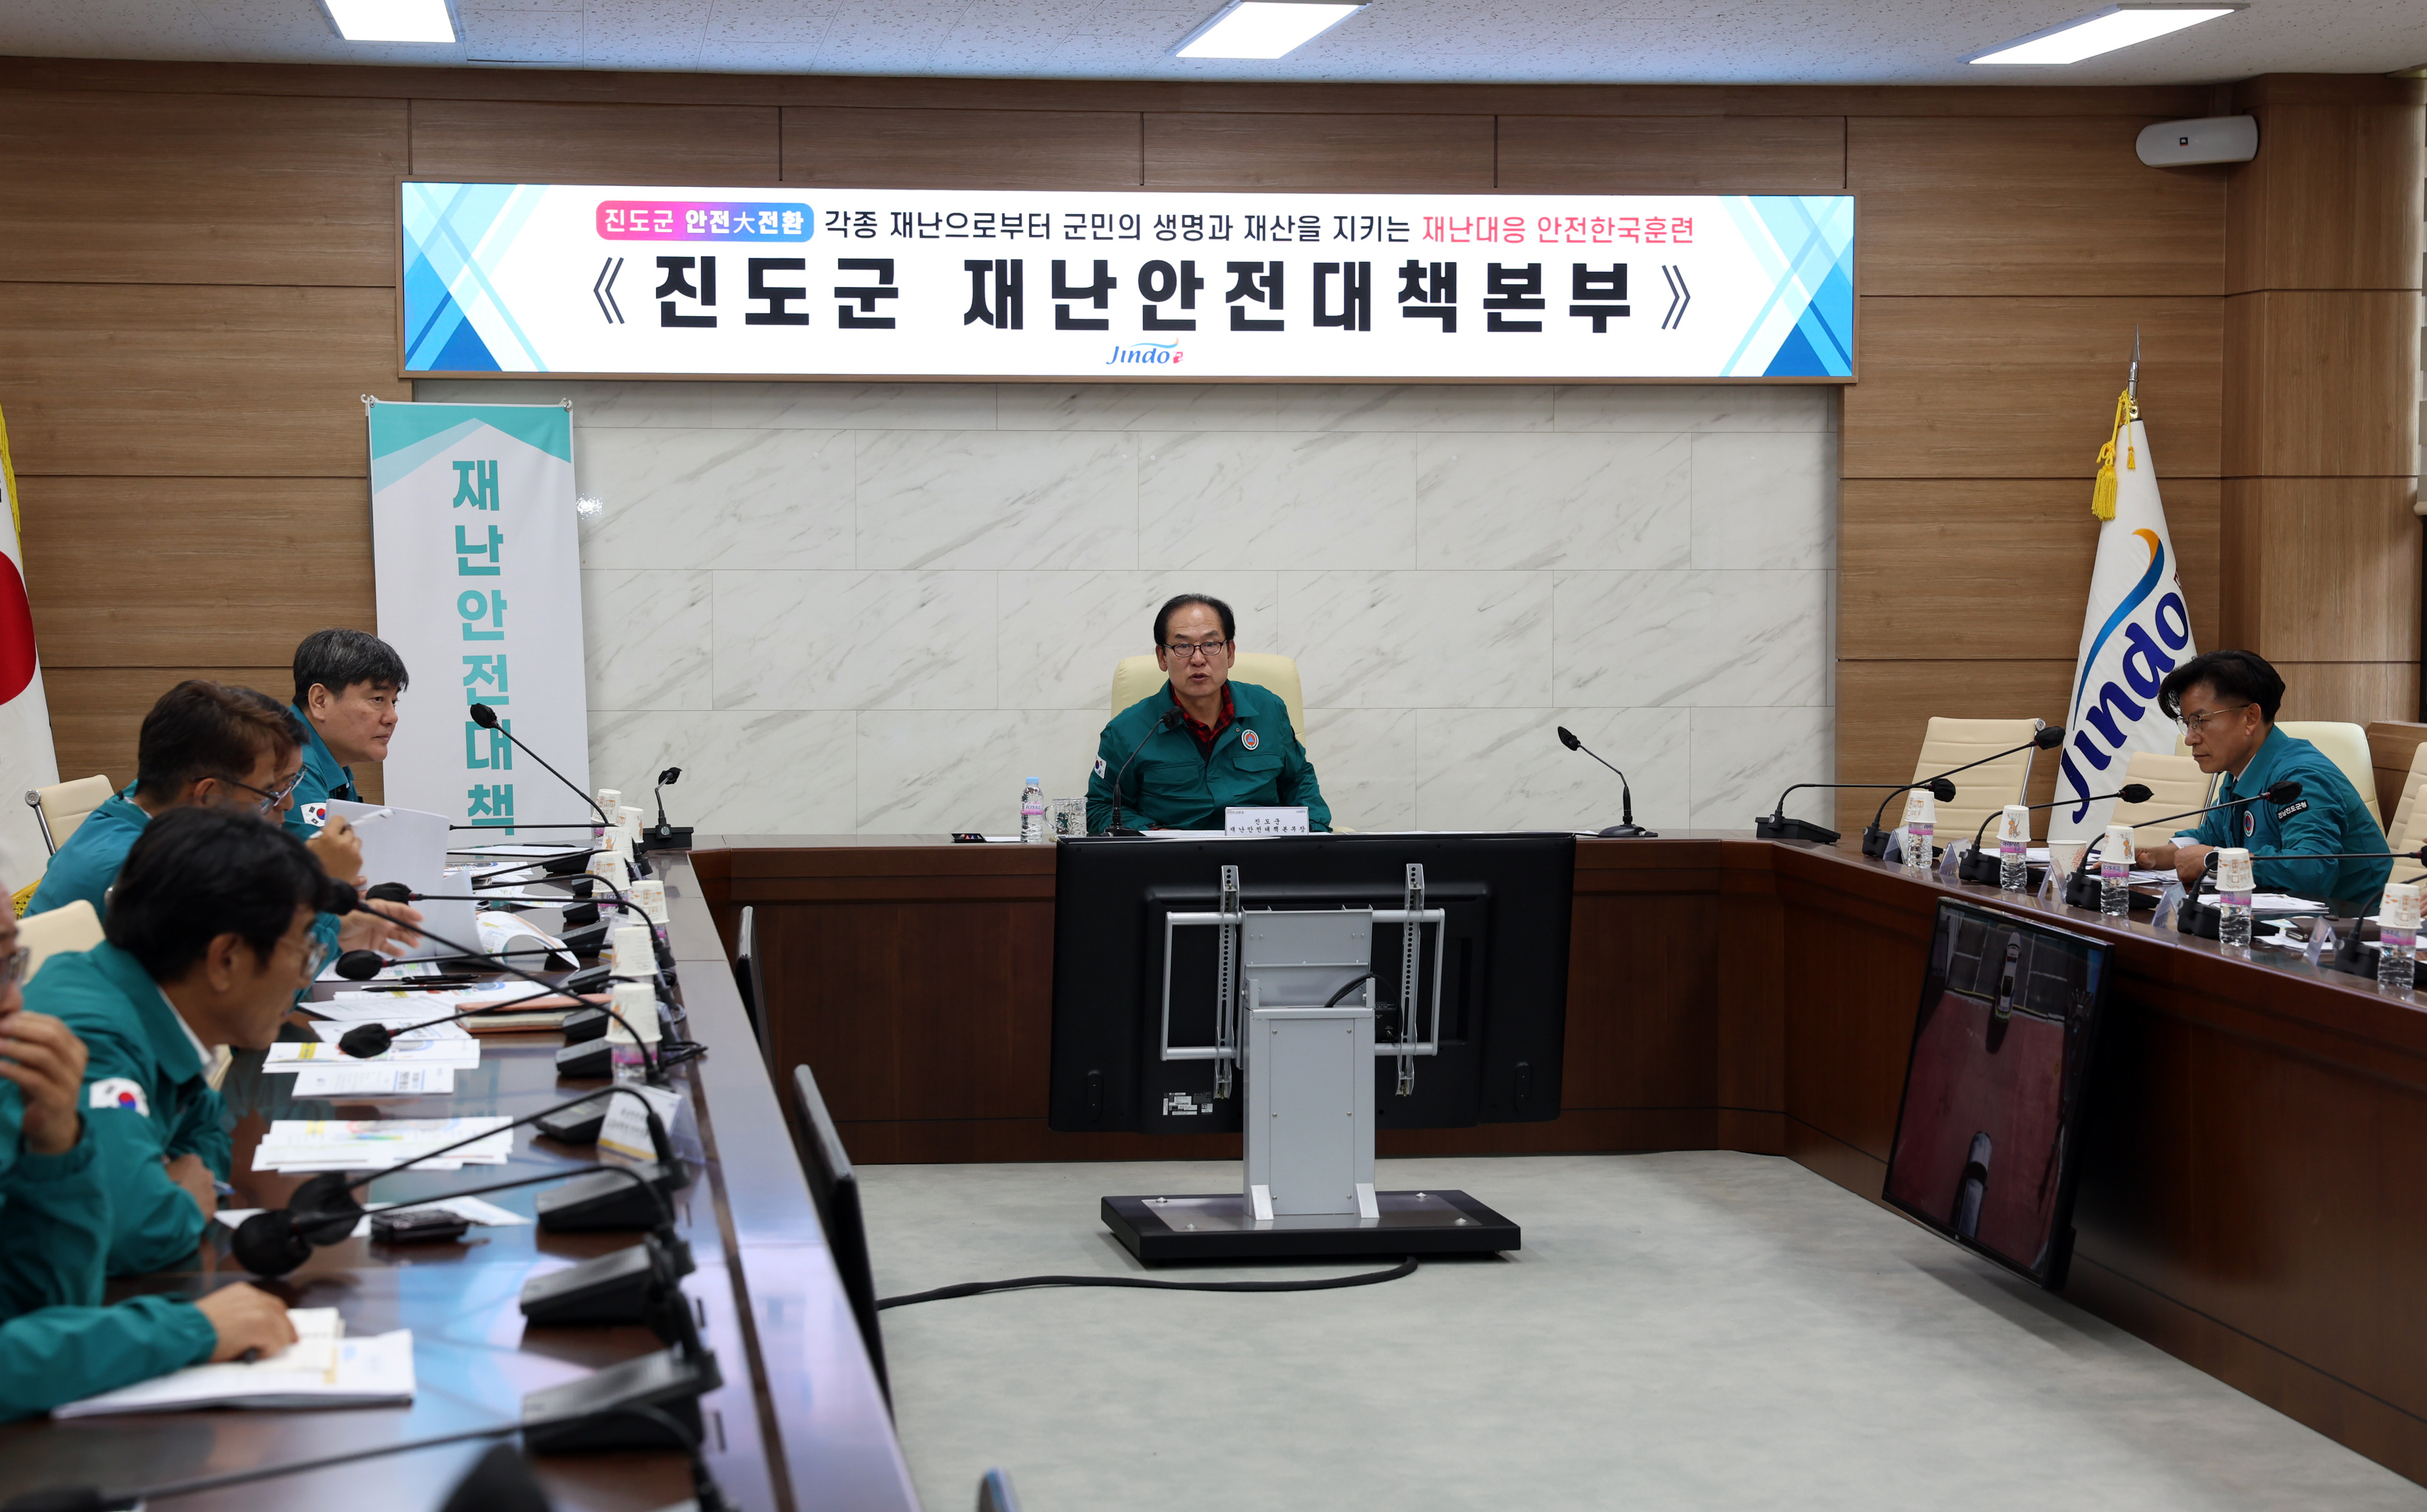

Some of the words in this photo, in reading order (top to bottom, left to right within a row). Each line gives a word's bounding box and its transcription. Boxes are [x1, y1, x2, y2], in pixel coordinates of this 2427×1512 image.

[606, 210, 673, 233] 진도군
[685, 210, 804, 235] 안전大전환
[825, 211, 877, 239] 각종
[891, 212, 1050, 239] 재난으로부터
[1064, 213, 1140, 240] 군민의
[1153, 214, 1234, 242] 생명과
[1244, 215, 1321, 242] 재산을
[1334, 216, 1410, 242] 지키는
[1422, 216, 1525, 244] 재난대응
[1538, 216, 1694, 244] 안전한국훈련
[1106, 345, 1170, 365] Jindo
[453, 460, 515, 847] 재난안전대책
[2060, 591, 2189, 824] Jindo
